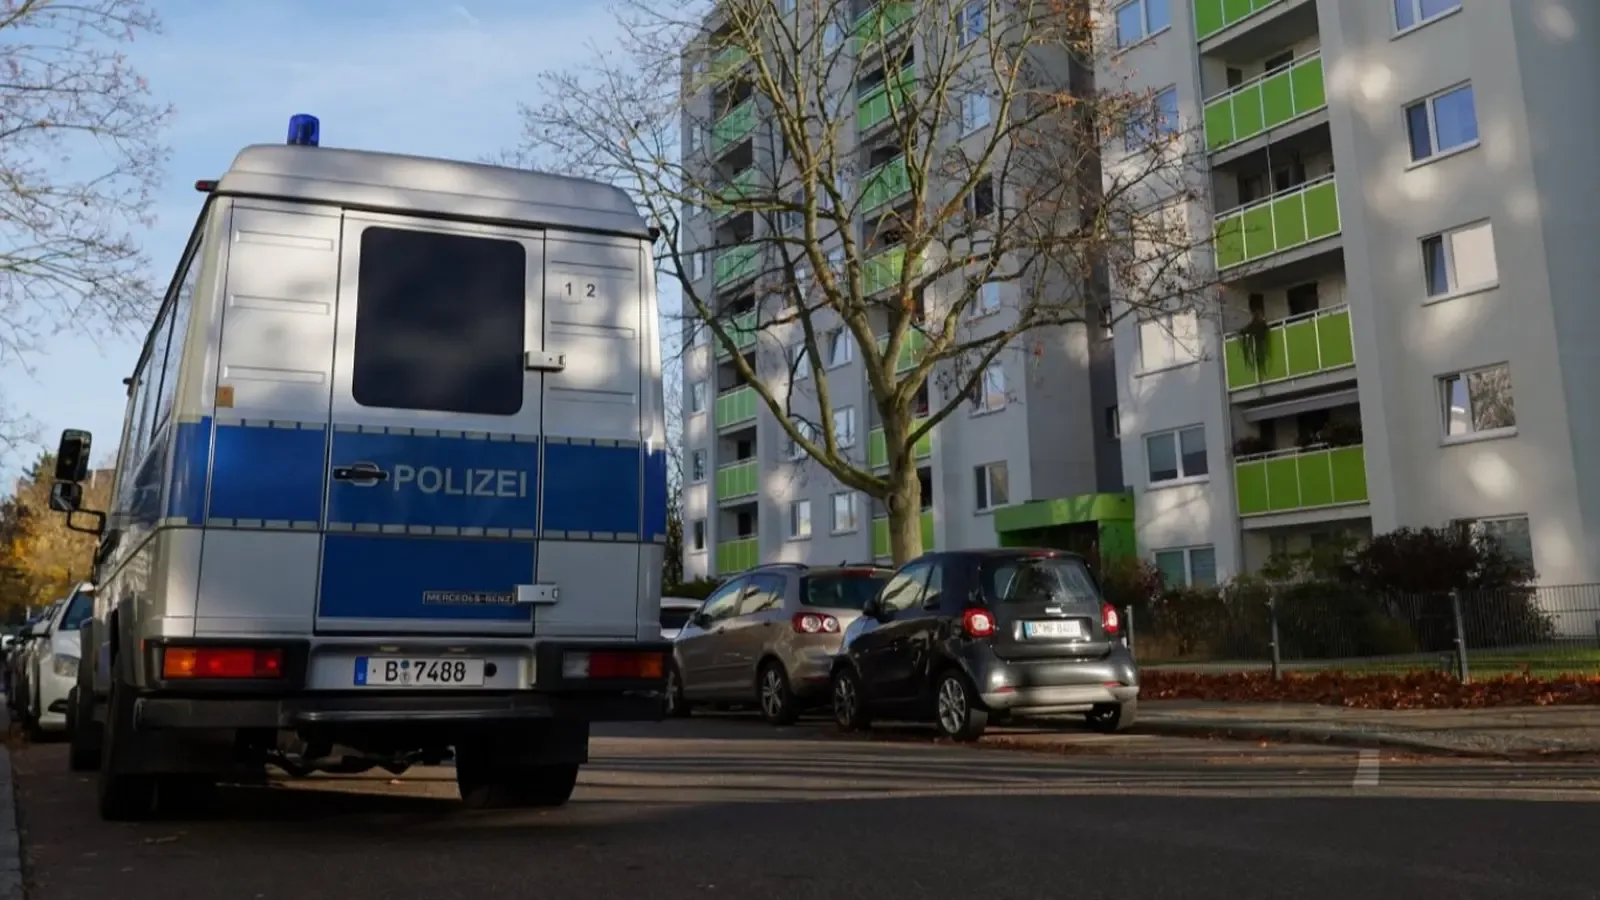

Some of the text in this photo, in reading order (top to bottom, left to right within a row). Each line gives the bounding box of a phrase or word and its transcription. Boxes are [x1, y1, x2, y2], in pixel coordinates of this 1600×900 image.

[393, 464, 527, 497] POLIZEI
[385, 660, 466, 682] B 7488
